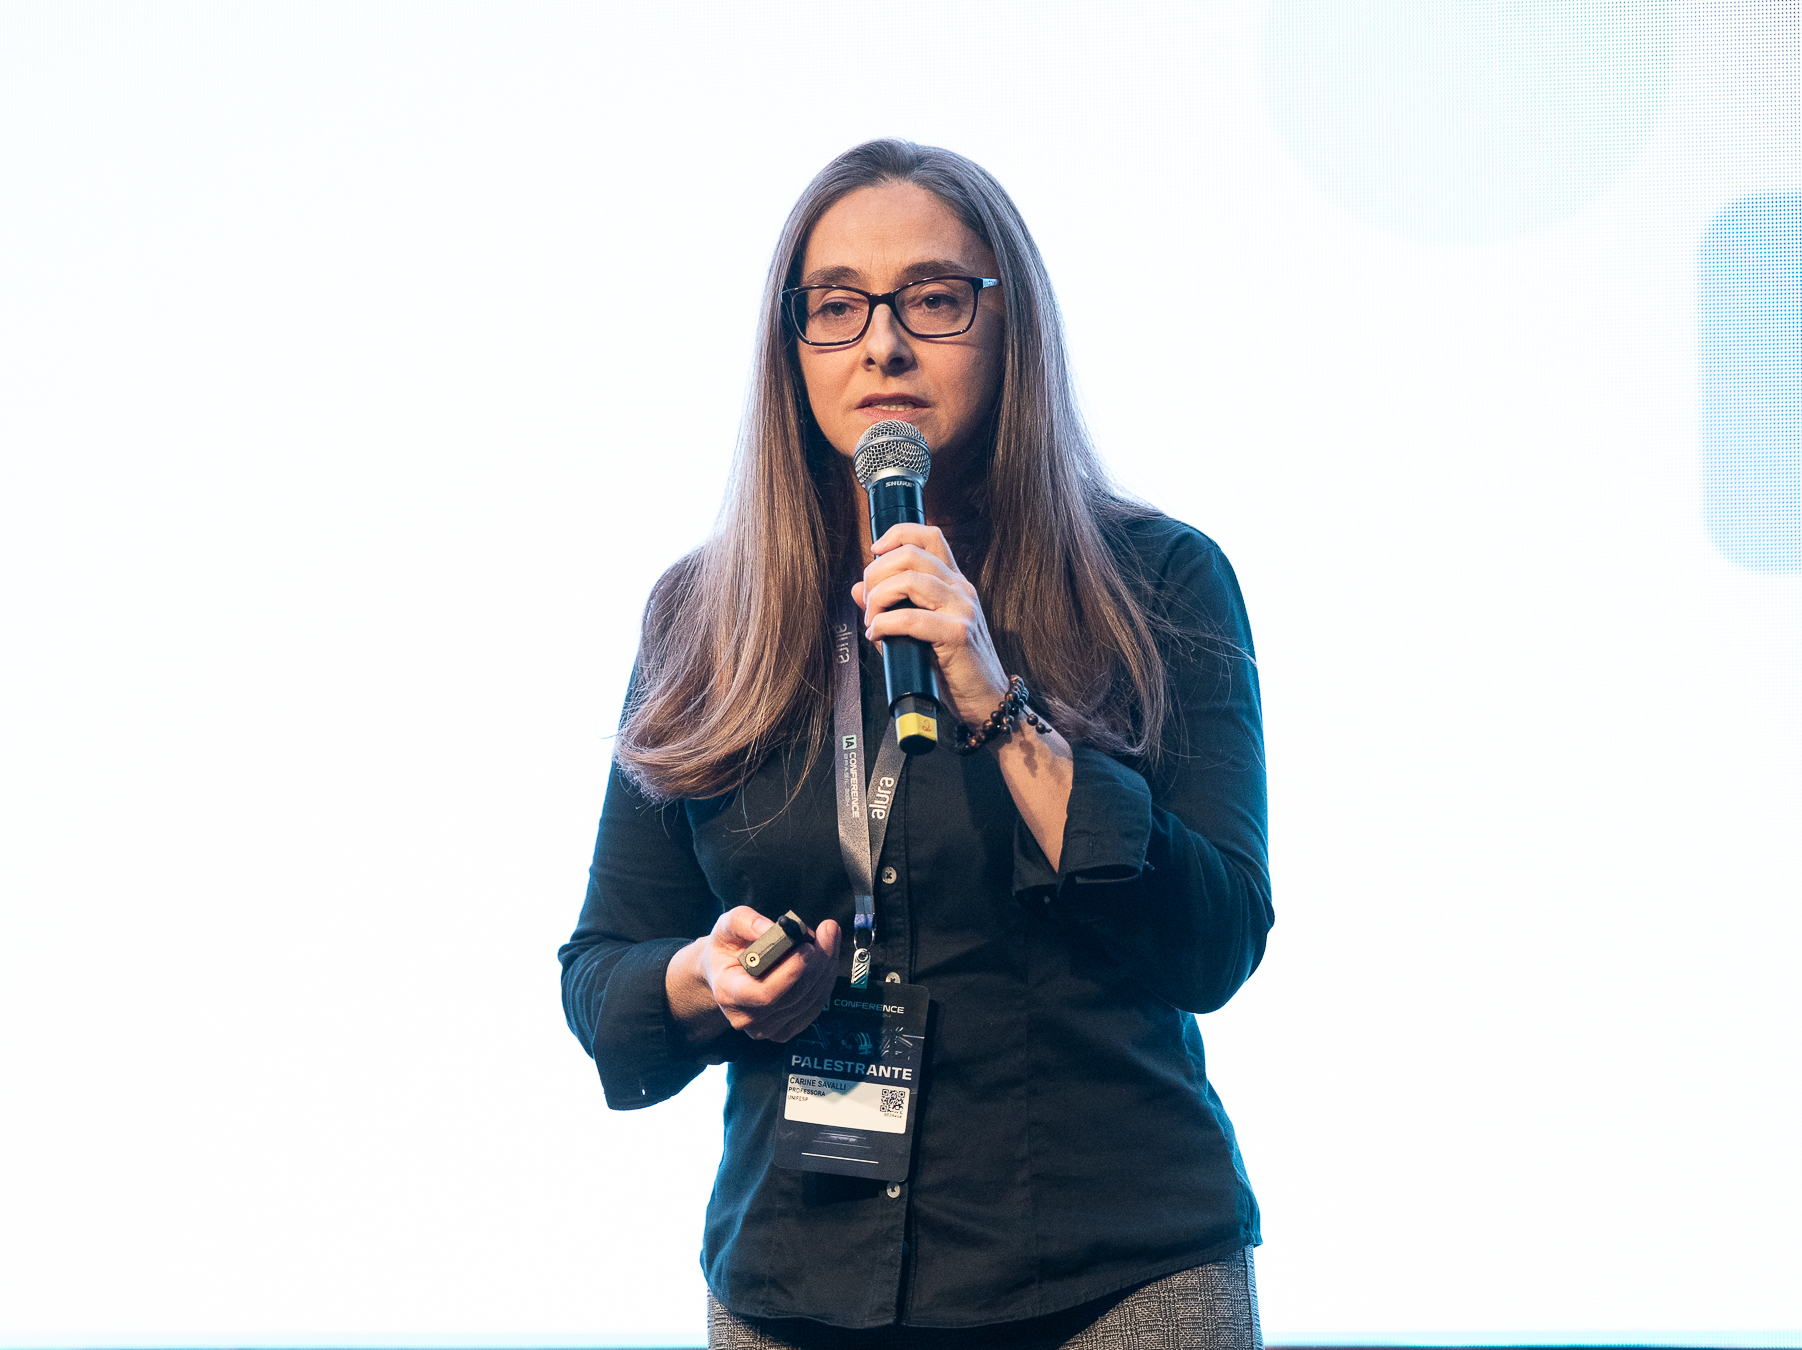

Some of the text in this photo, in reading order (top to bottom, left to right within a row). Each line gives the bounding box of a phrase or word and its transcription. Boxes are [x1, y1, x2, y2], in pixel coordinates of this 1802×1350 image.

[834, 622, 852, 665] alura
[844, 736, 860, 818] IA CONFERENCE
[868, 776, 895, 820] alura
[833, 998, 905, 1014] CONFERENCE
[791, 1054, 913, 1081] PALESTRANTE
[788, 1086, 826, 1096] PROFESSORA
[789, 1076, 847, 1091] CARINE SAVALLI
